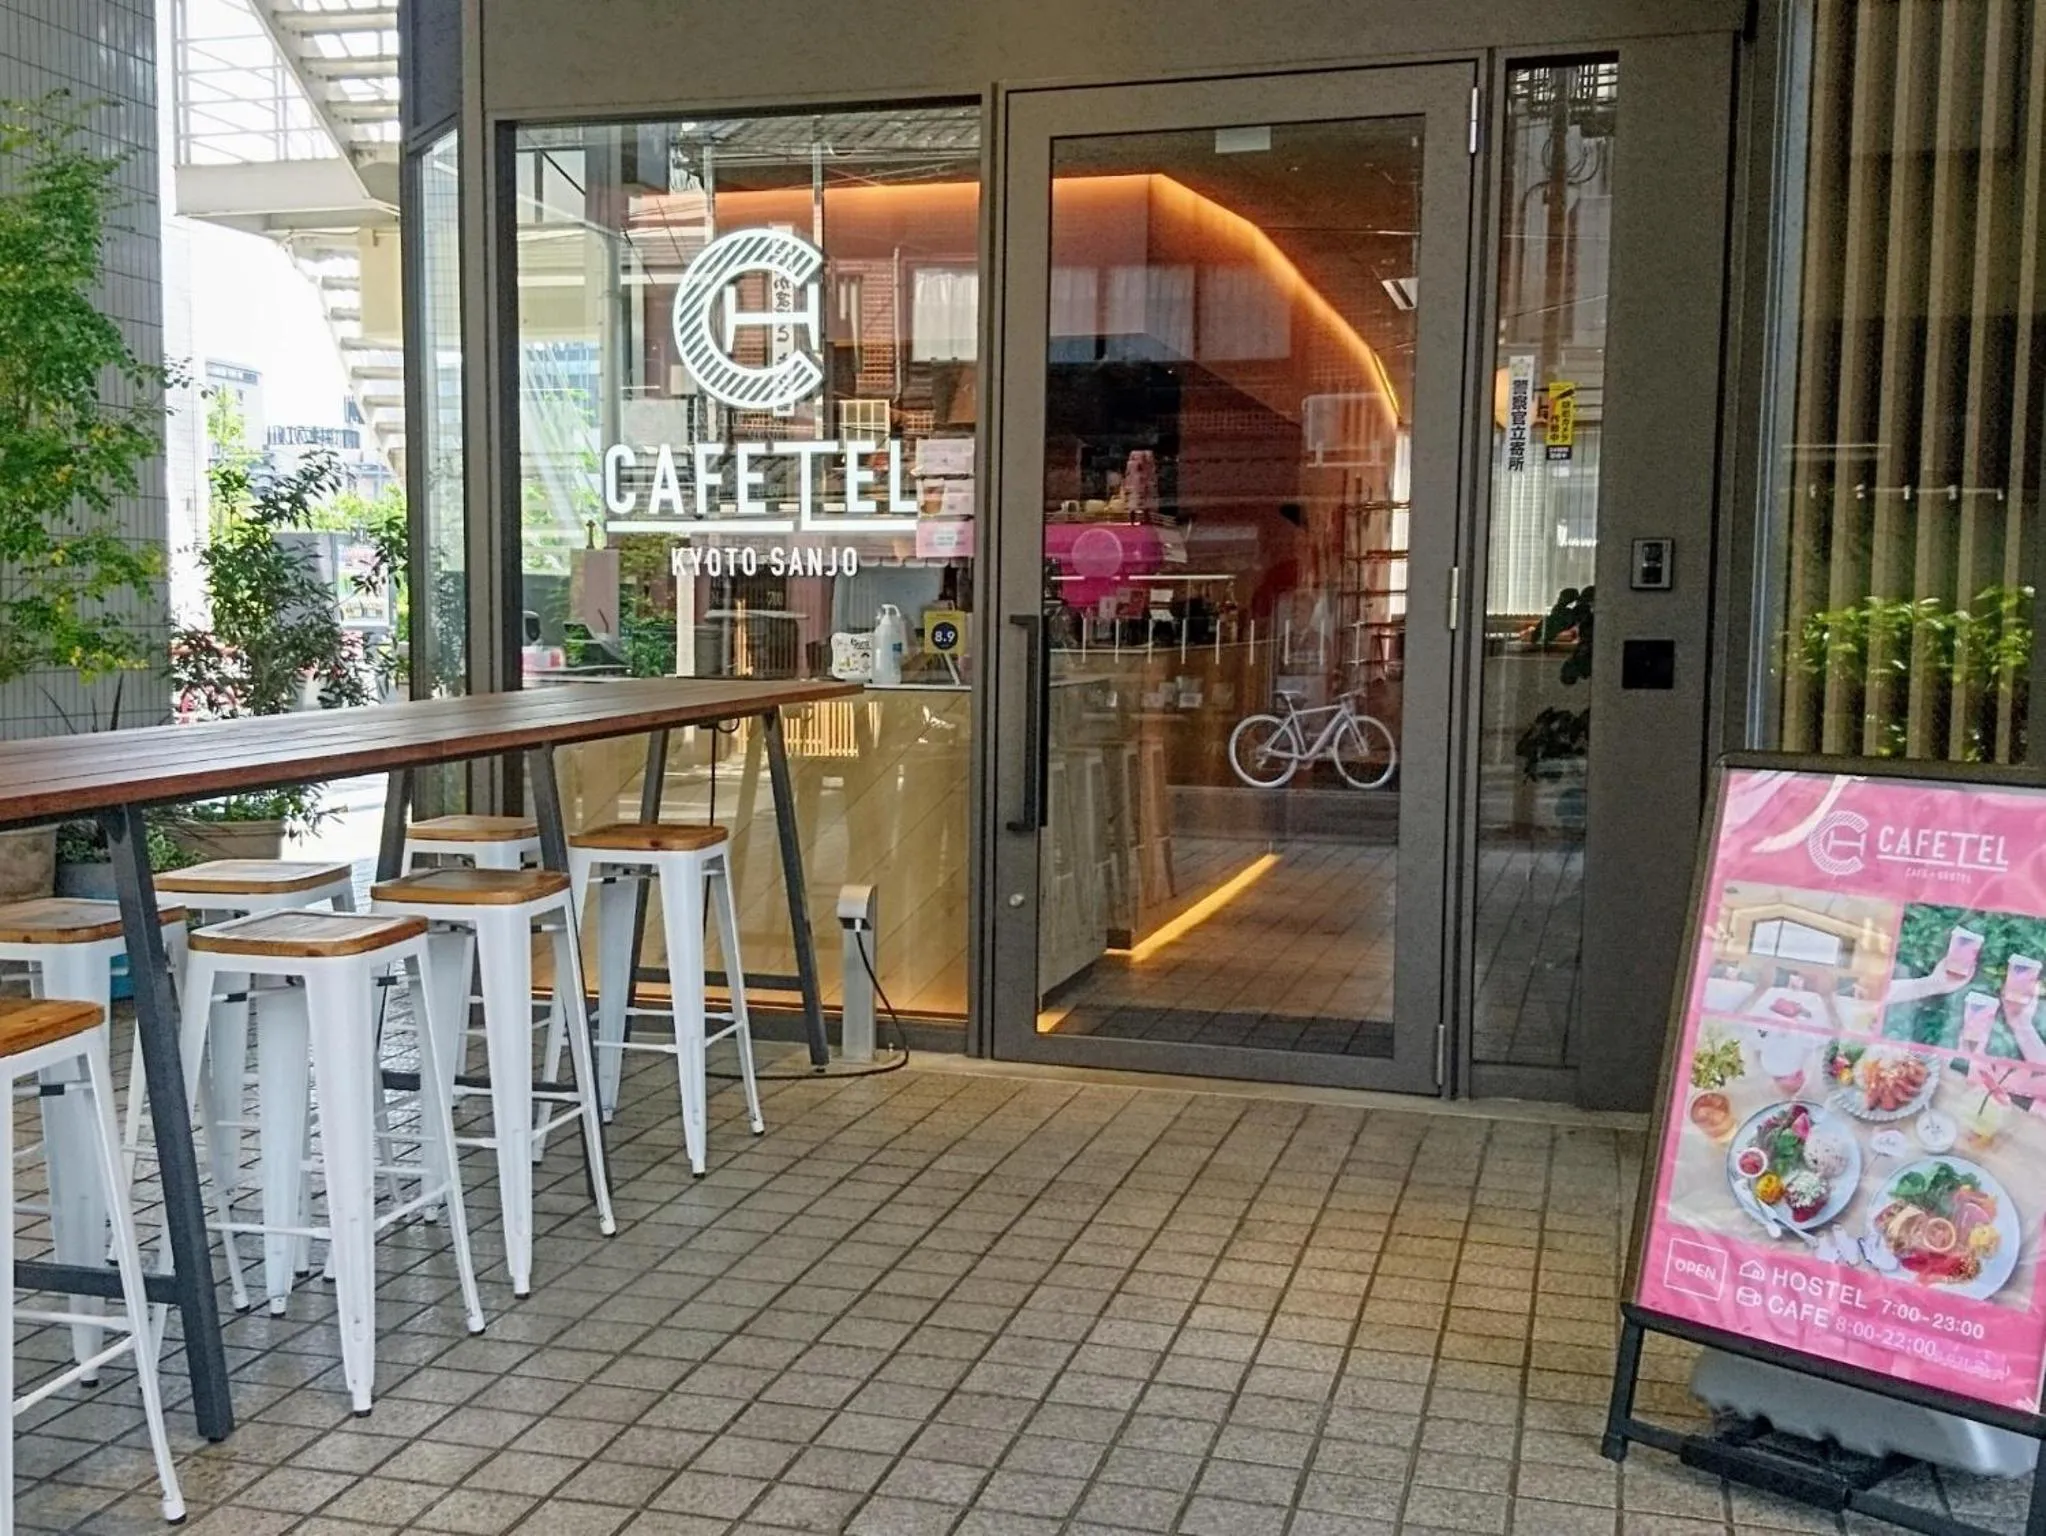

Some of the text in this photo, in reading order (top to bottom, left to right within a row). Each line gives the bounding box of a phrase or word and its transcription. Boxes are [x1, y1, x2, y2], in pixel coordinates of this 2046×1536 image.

[605, 438, 918, 532] CAFETEL
[671, 547, 858, 577] KYOTO SANJO
[934, 631, 956, 642] 8.9
[1877, 825, 2009, 871] CAFETEL
[1675, 1259, 1717, 1281] OPEN
[1768, 1295, 1830, 1328] CAFE
[1772, 1267, 1985, 1340] HOSTEL 7:00-23:00
